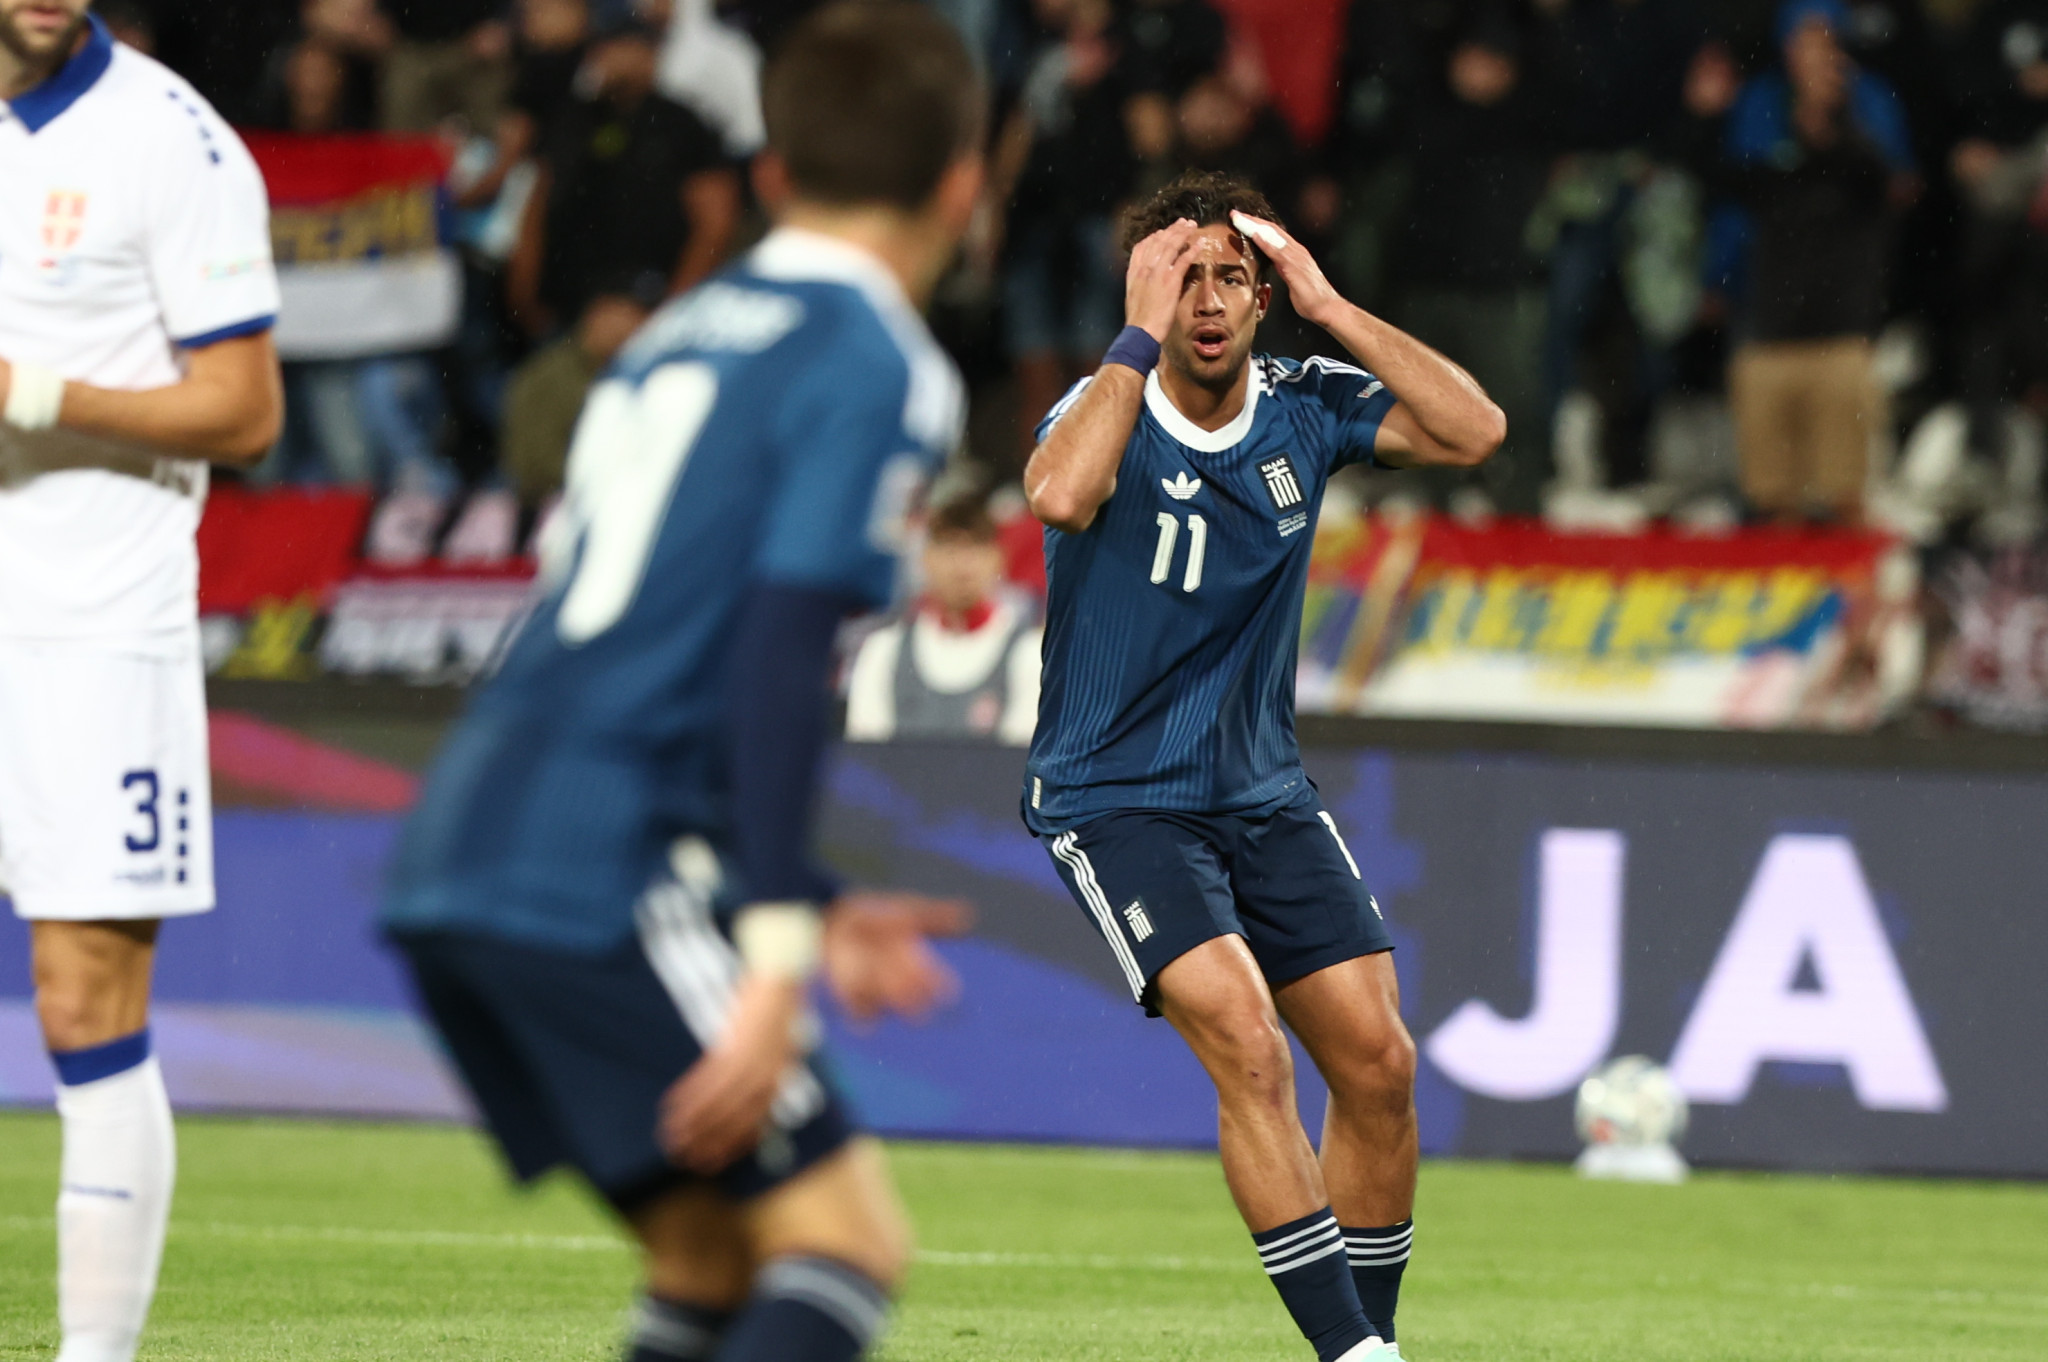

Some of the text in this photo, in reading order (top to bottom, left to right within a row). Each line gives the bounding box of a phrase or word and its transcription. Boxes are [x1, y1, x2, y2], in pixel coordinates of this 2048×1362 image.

[1150, 511, 1208, 593] 11
[122, 769, 160, 854] 3
[1425, 826, 1949, 1113] JA
